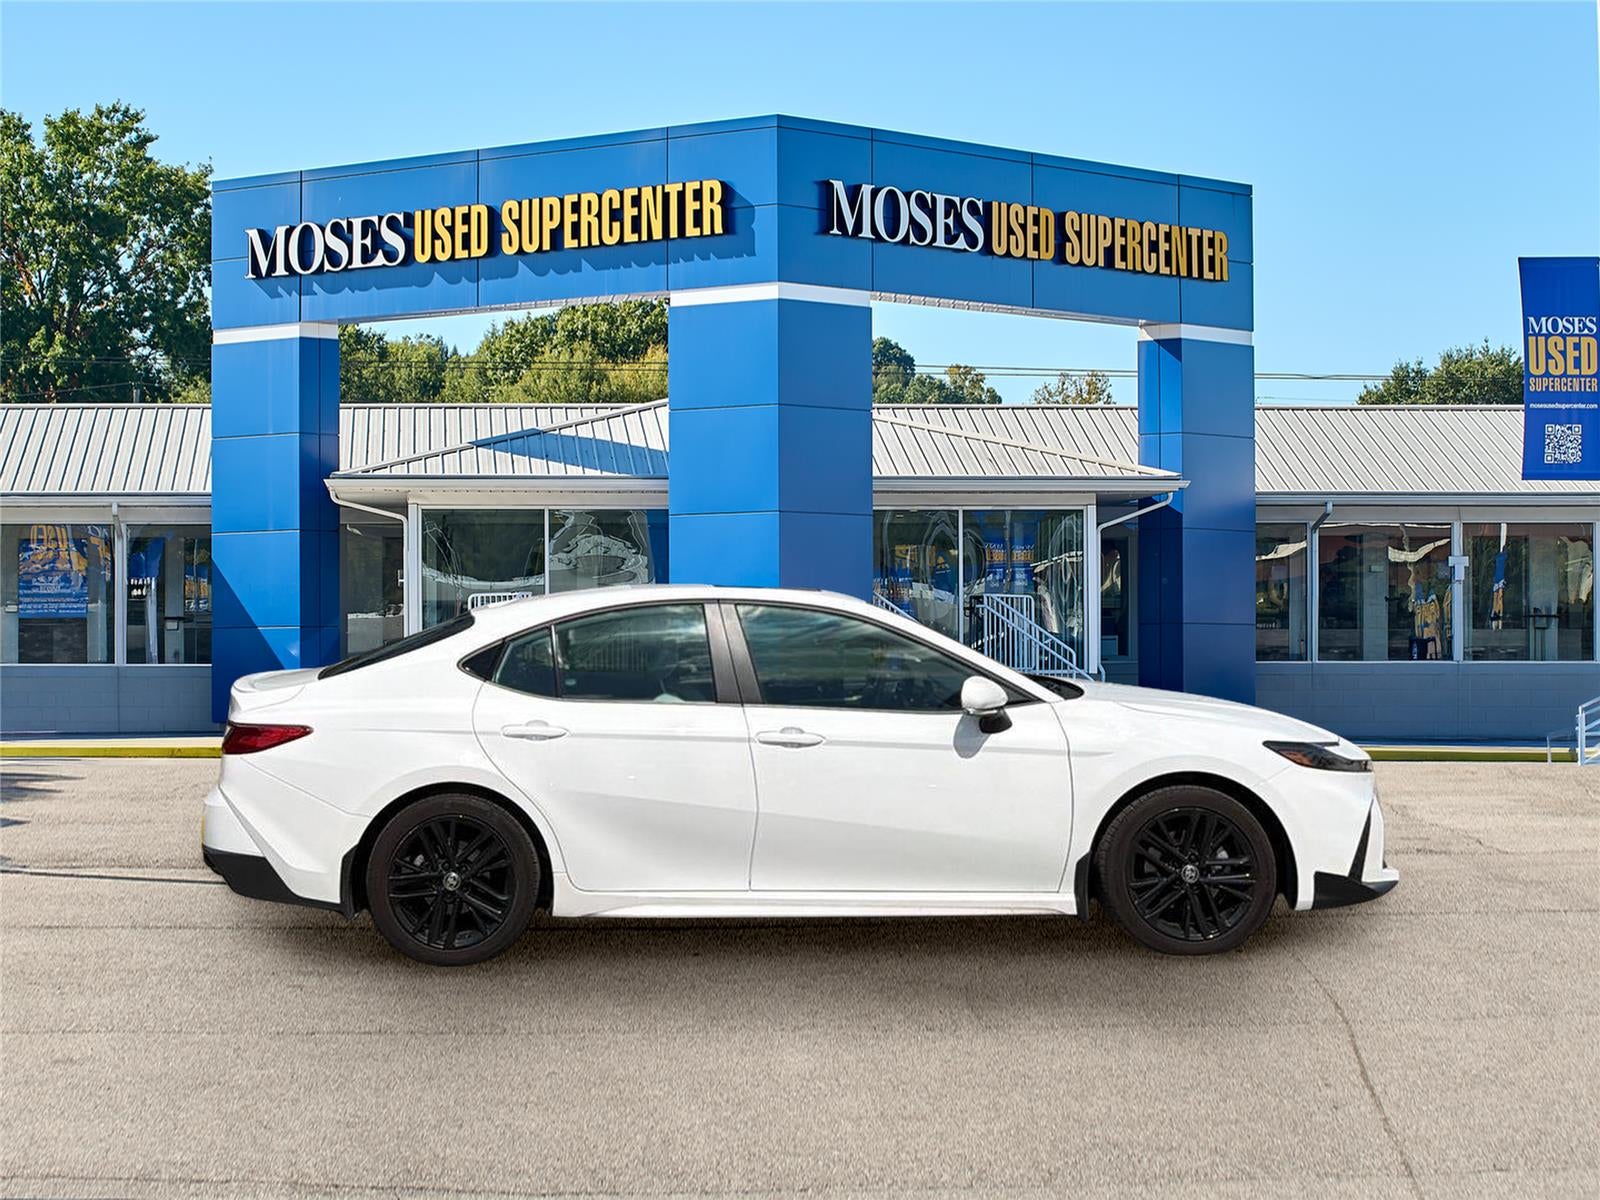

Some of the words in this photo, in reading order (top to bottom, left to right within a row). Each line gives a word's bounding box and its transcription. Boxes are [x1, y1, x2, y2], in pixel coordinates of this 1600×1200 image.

[246, 212, 410, 279] MOSES
[413, 204, 489, 264] USED
[500, 178, 724, 256] SUPERCENTER
[828, 179, 985, 253] MOSES
[991, 200, 1056, 261] USED
[1064, 211, 1230, 282] SUPERCENTER
[1527, 316, 1597, 335] MOSES
[1528, 336, 1598, 376] USED
[1529, 377, 1598, 392] SUPERCENTER
